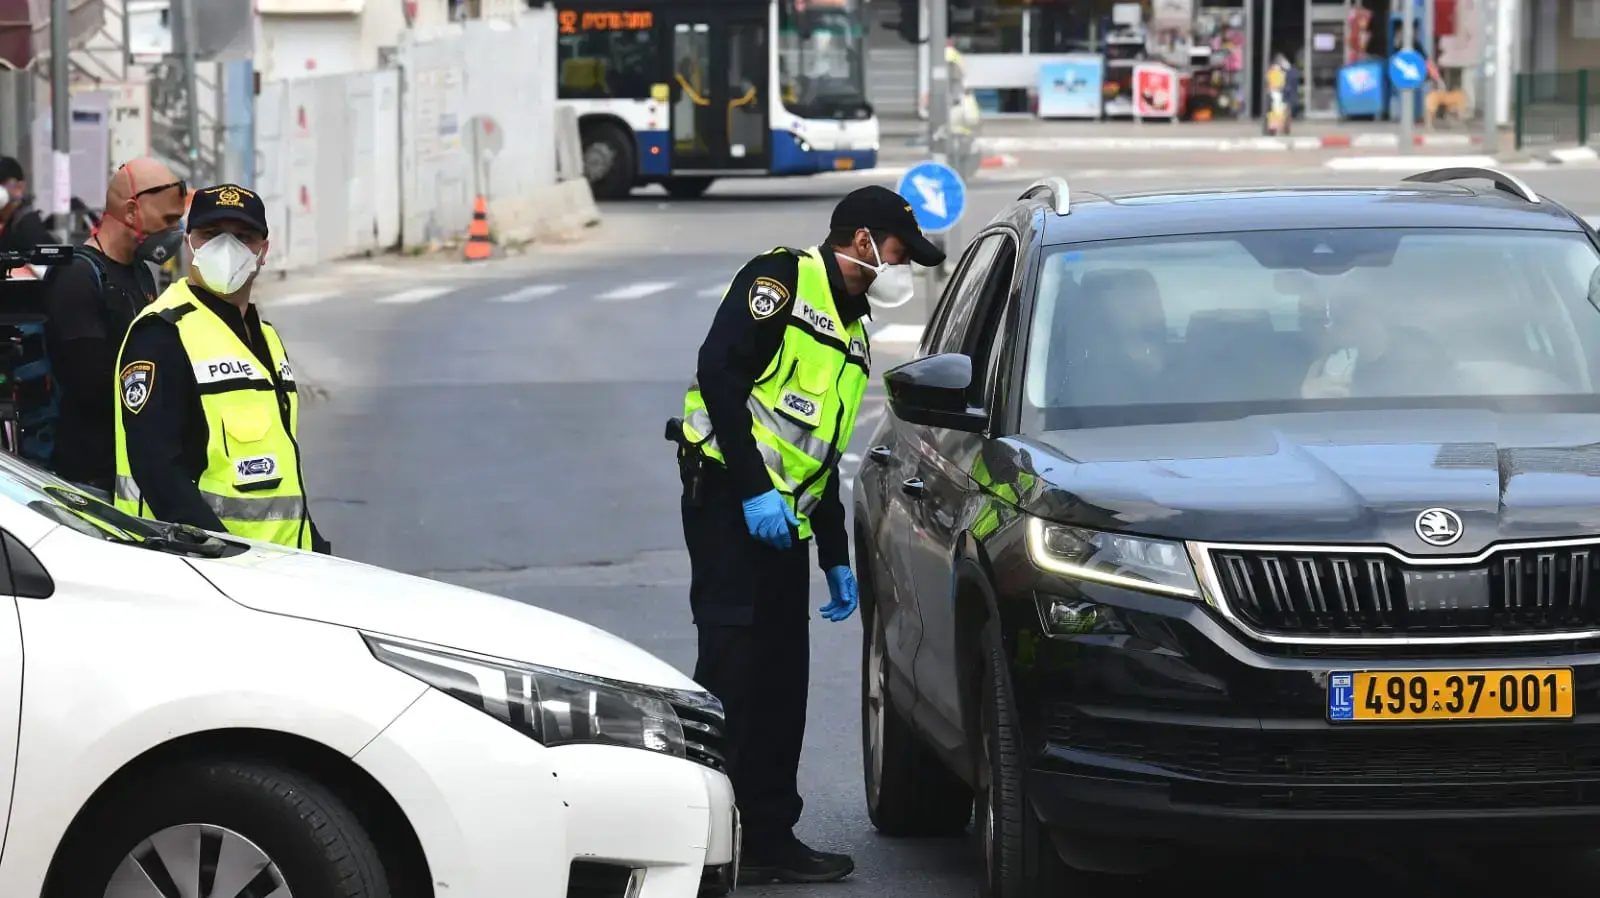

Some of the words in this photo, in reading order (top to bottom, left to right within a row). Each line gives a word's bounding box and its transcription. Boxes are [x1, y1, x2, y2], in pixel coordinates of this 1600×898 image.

[803, 304, 835, 332] POICE
[207, 361, 253, 377] POLIE
[1335, 687, 1349, 706] IL
